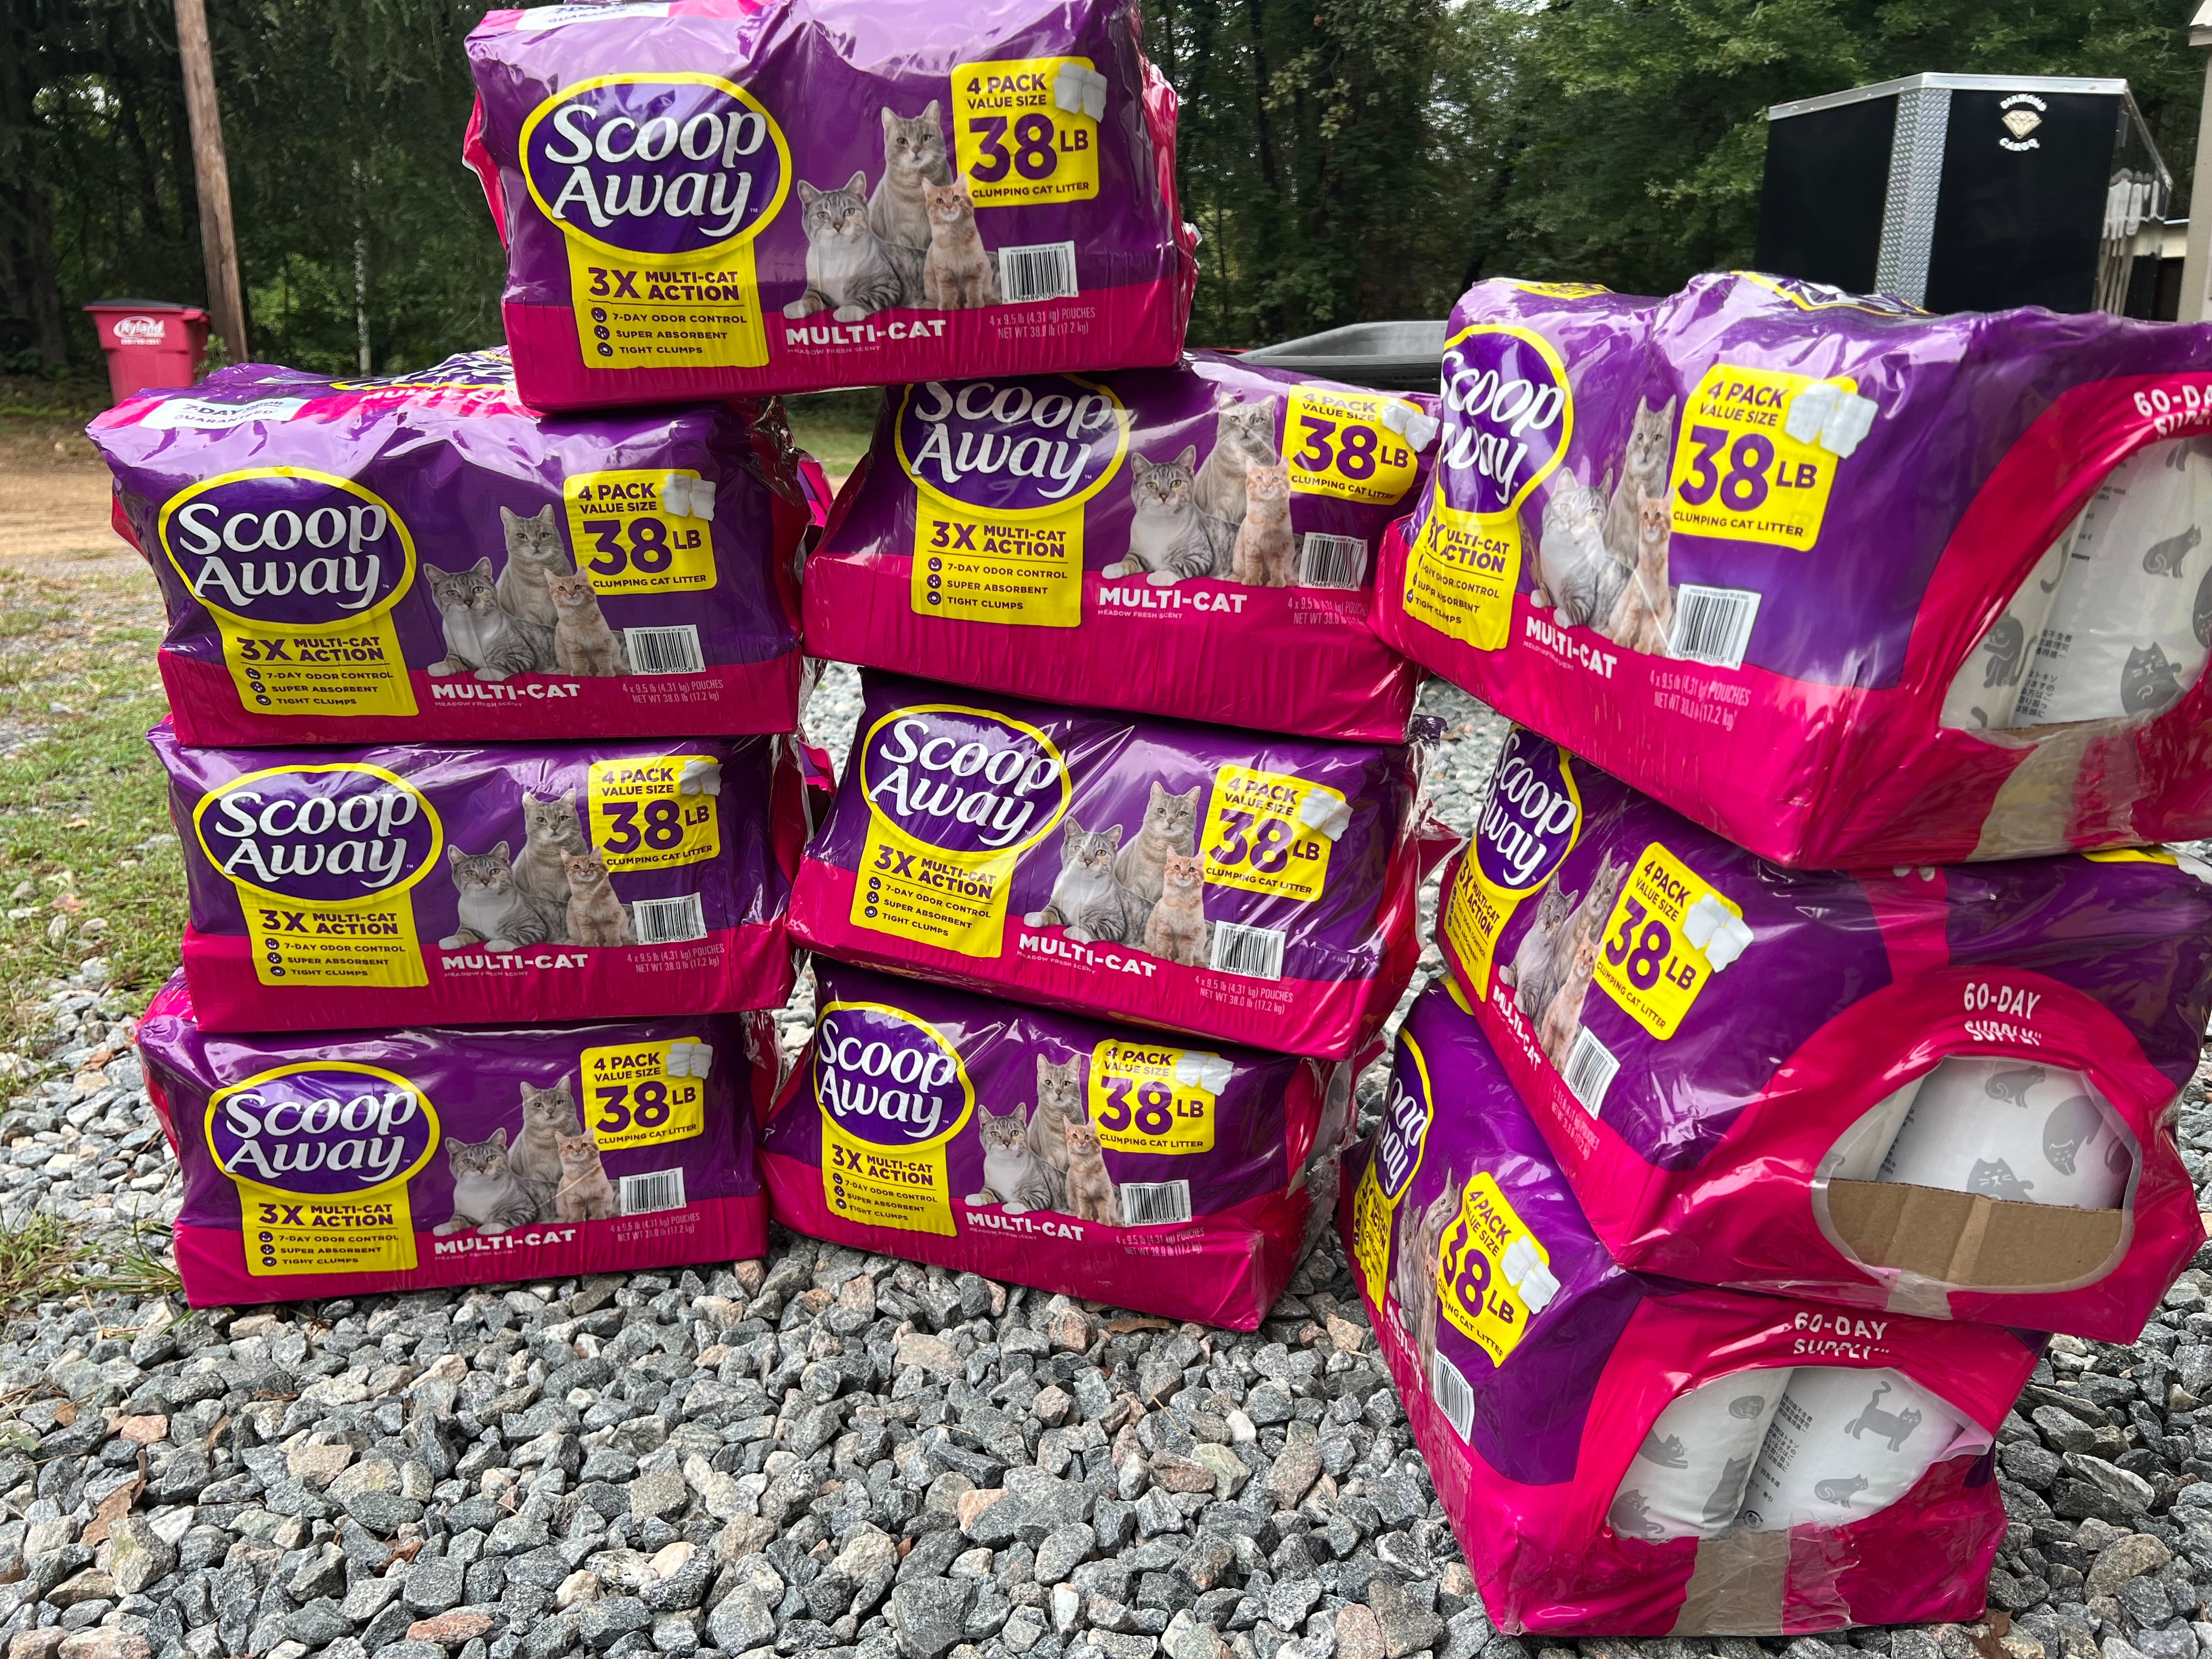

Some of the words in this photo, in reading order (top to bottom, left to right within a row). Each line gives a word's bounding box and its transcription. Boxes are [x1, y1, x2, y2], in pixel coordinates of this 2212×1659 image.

[966, 77, 982, 95] 4
[987, 73, 1050, 94] PACK
[967, 96, 1013, 110] VALUE
[1016, 93, 1047, 107] SIZE
[544, 104, 767, 169] Scoop
[968, 112, 1058, 184] 38
[1060, 128, 1089, 153] LB
[551, 166, 753, 237] Away
[971, 187, 1030, 199] CLUMPING
[1032, 185, 1054, 195] CAT
[1055, 181, 1090, 194] LITTER
[588, 267, 642, 300] 3X
[645, 271, 738, 284] MULTI-CAT
[647, 284, 740, 302] ACTION
[612, 312, 648, 322] 7-DAY
[651, 314, 686, 323] ODOR
[689, 315, 748, 324] CONTROL
[785, 319, 946, 346] MULTI-CAT
[997, 327, 1013, 339] NET
[1014, 325, 1028, 339] WT
[1029, 324, 1047, 338] 38.0
[1048, 323, 1055, 336] lb
[1057, 321, 1075, 337] (17.2
[1077, 321, 1089, 335] kg)
[616, 329, 653, 339] SUPER
[656, 331, 728, 340] ABSORBENT
[618, 346, 653, 354] TIGHT
[915, 381, 1112, 440] Scoop
[1707, 380, 1725, 400] 4
[1725, 382, 1787, 410] PACK
[1302, 403, 1344, 418] VALUE
[1346, 411, 1375, 422] SIZE
[1699, 402, 1745, 422] VALUE
[1745, 410, 1779, 427] SIZE
[910, 422, 1092, 498] Away
[1292, 414, 1378, 482] 38
[1380, 445, 1409, 468] LB
[1677, 424, 1775, 513] 38
[1775, 460, 1817, 489] LB
[578, 486, 593, 502] 4
[597, 482, 657, 501] PACK
[177, 502, 388, 556] Scoop
[930, 520, 978, 551] 3X
[983, 524, 1067, 542] MULTI-CAT
[1673, 510, 1728, 527] CLUMPING
[1730, 518, 1755, 529] CAT
[1757, 521, 1804, 537] LITTER
[582, 517, 673, 576] 38
[672, 529, 702, 550] LB
[982, 537, 1065, 558] ACTION
[194, 554, 381, 611] Away
[592, 578, 649, 588] CLUMPING
[650, 577, 671, 586] CAT
[672, 574, 707, 584] LITTER
[1456, 580, 1499, 599] CONTROL
[1097, 586, 1248, 616] MULTI-CAT
[1097, 609, 1132, 617] MEADOW
[1132, 611, 1158, 619] FRESH
[236, 637, 294, 661] 3X
[293, 636, 380, 648] MULTI-CAT
[299, 647, 385, 662] ACTION
[1526, 616, 1618, 679] MULTI-CAT
[430, 683, 581, 700] MULTI-CAT
[880, 719, 1060, 797] Scoop
[601, 785, 643, 797] VALUE
[645, 784, 675, 794] SIZE
[1227, 777, 1241, 792] 4
[1242, 779, 1300, 807] PACK
[1495, 732, 1577, 838] Scoop
[215, 791, 418, 838] Scoop
[868, 765, 1035, 847] Away
[602, 799, 684, 855] 38
[684, 805, 710, 827] LB
[1209, 806, 1299, 874] 38
[1292, 839, 1320, 861] LB
[1479, 781, 1547, 885] Away
[223, 838, 407, 888] Away
[873, 844, 918, 879] 3X
[920, 858, 997, 885] MULTI-CAT
[915, 868, 993, 900] ACTION
[1636, 877, 1660, 905] VALUE
[1658, 900, 1680, 922] SIZE
[1644, 861, 1656, 877] 4
[1651, 866, 1692, 908] PACK
[883, 899, 914, 913] SUPER
[915, 905, 973, 931] ABSORBENT
[885, 884, 914, 898] 7-DAY
[915, 893, 943, 907] ODOR
[945, 902, 991, 918] CONTROL
[1467, 892, 1494, 938] ACTION
[1472, 881, 1500, 924] MULTI-CAT
[258, 908, 310, 933] 3X
[312, 912, 397, 923] MULTI-CAT
[316, 922, 399, 935] ACTION
[882, 912, 910, 925] TIGHT
[911, 921, 949, 937] CLUMPS
[1018, 933, 1157, 978] MULTI-CAT
[1605, 895, 1672, 991] 38
[1665, 956, 1697, 991] LB
[441, 953, 589, 970] MULTI-CAT
[1194, 975, 1200, 984] 4
[1206, 978, 1218, 990] 9.5
[1219, 980, 1227, 991] lb
[1228, 982, 1246, 995] (4.31
[1247, 986, 1259, 999] kg)
[1260, 987, 1294, 1003] POUCHES
[1964, 982, 2041, 1020] 60-DAY
[1626, 991, 1641, 1007] CAT
[1641, 1003, 1666, 1029] LITTER
[819, 1018, 957, 1093] Scoop
[226, 1091, 418, 1138] Scoop
[595, 1080, 671, 1134] 38
[672, 1086, 696, 1106] LB
[819, 1065, 943, 1138] Away
[1097, 1075, 1173, 1136] 38
[1176, 1099, 1205, 1118] LB
[225, 1135, 405, 1182] Away
[831, 1143, 864, 1174] 3X
[866, 1154, 933, 1178] MULTI-CAT
[868, 1163, 934, 1187] ACTION
[1469, 1191, 1484, 1203] 4
[258, 1202, 305, 1226] 3X
[310, 1203, 393, 1214] MULTI-CAT
[311, 1213, 394, 1228] ACTION
[965, 1211, 1084, 1241] MULTI-CAT
[1474, 1198, 1513, 1246] PACK
[434, 1229, 577, 1255] MULTI-CAT
[1479, 1229, 1501, 1257] SIZE
[1442, 1218, 1491, 1318] 38
[1487, 1289, 1515, 1324] LB
[1460, 1315, 1475, 1332] CAT
[1477, 1329, 1503, 1358] LITTER
[1794, 1312, 1888, 1340] 60-DAY
